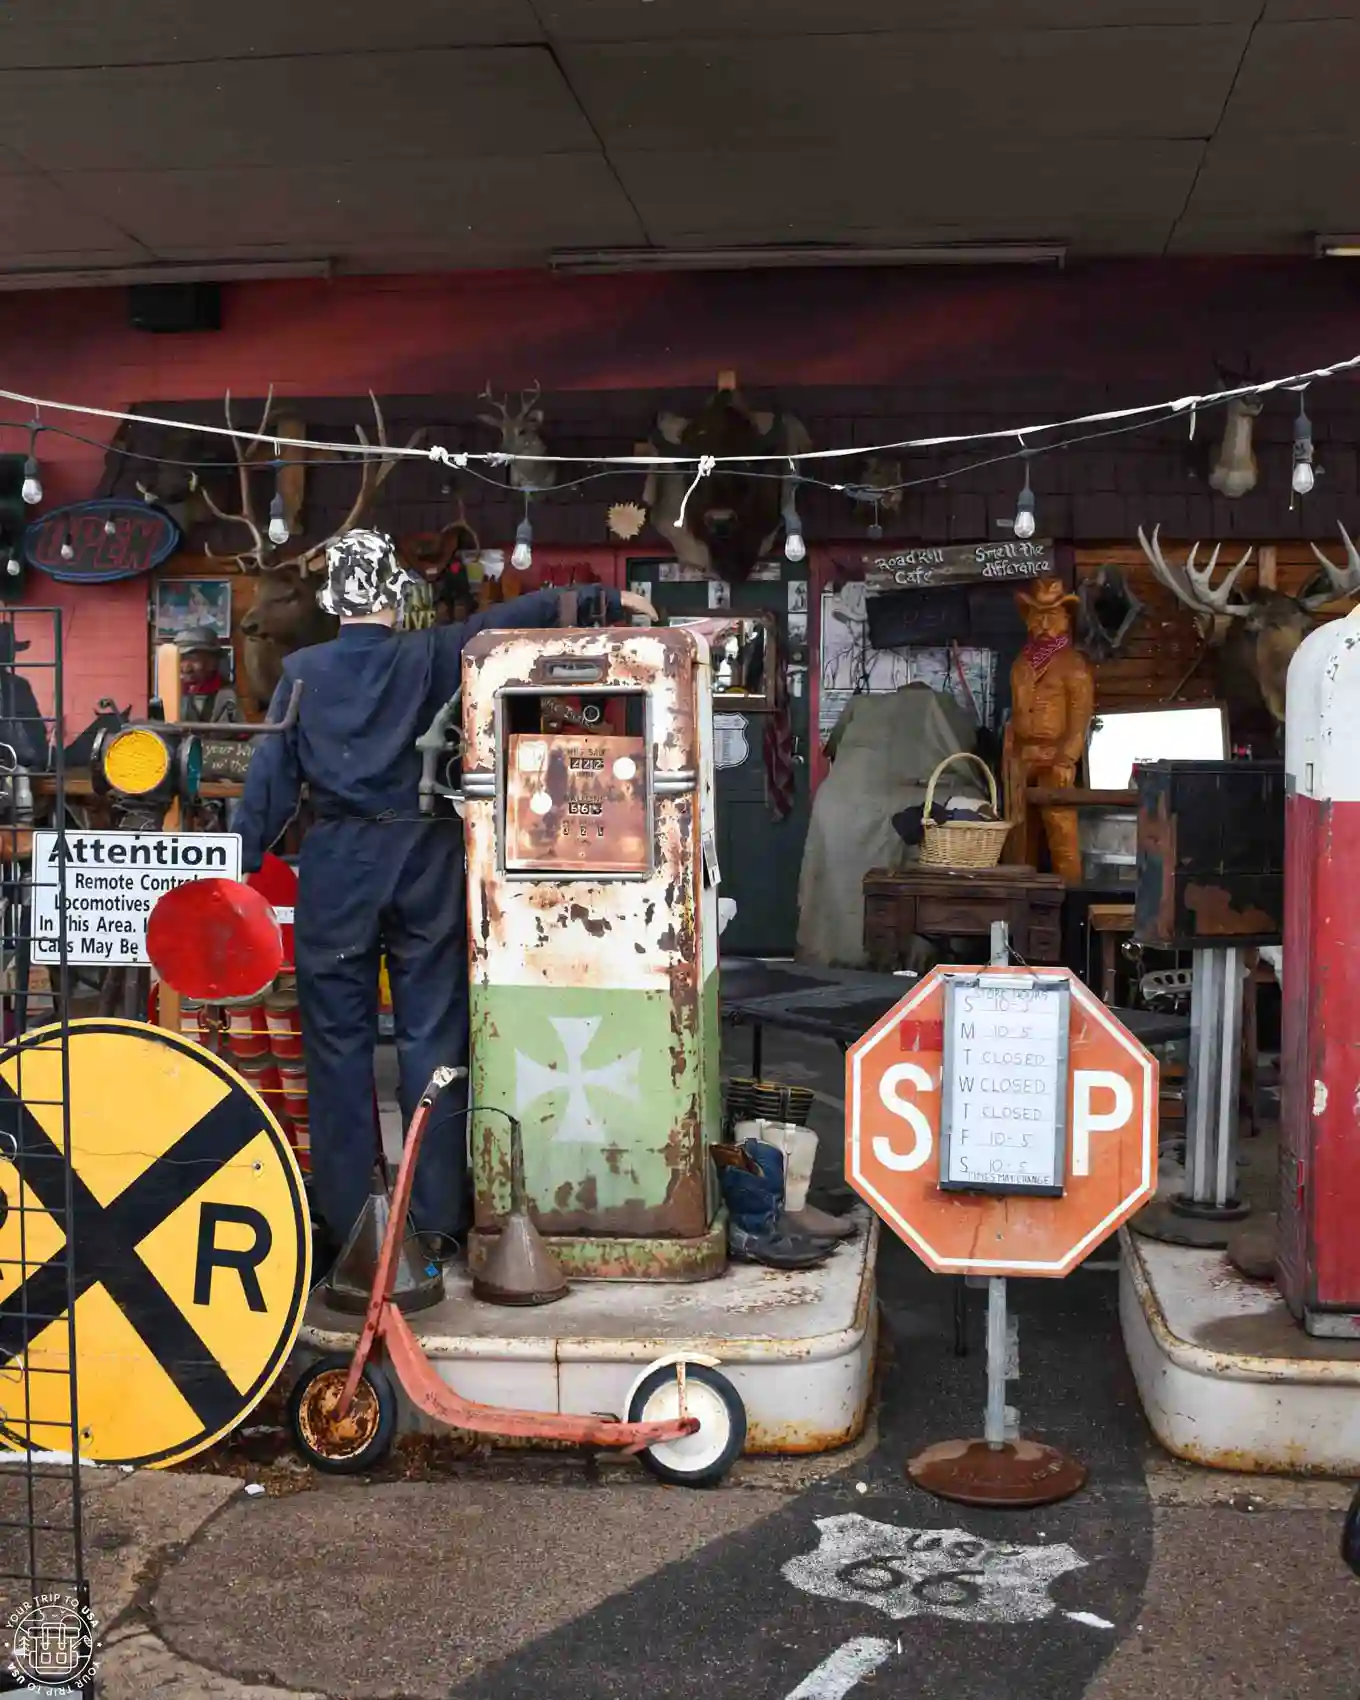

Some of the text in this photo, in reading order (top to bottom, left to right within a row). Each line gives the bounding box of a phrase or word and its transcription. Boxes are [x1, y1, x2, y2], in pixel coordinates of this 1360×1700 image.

[36, 516, 165, 571] OPEN
[975, 543, 1016, 562] Smell
[48, 834, 227, 866] Attention
[75, 873, 199, 891] Remote Contr
[54, 894, 150, 912] Locomotives
[39, 915, 54, 931] In
[65, 915, 90, 932] his
[96, 916, 137, 933] Area.
[81, 938, 113, 958] May
[120, 939, 139, 954] Be
[963, 996, 974, 1012] S
[960, 1022, 975, 1039] M
[963, 1048, 1045, 1066] T CLOSED
[958, 1075, 1046, 1094] W CLOSED
[962, 1102, 1041, 1121] T CLOSED
[961, 1128, 969, 1145] F
[959, 1156, 969, 1173] S
[193, 1201, 272, 1313] R
[834, 1553, 985, 1605] 66
